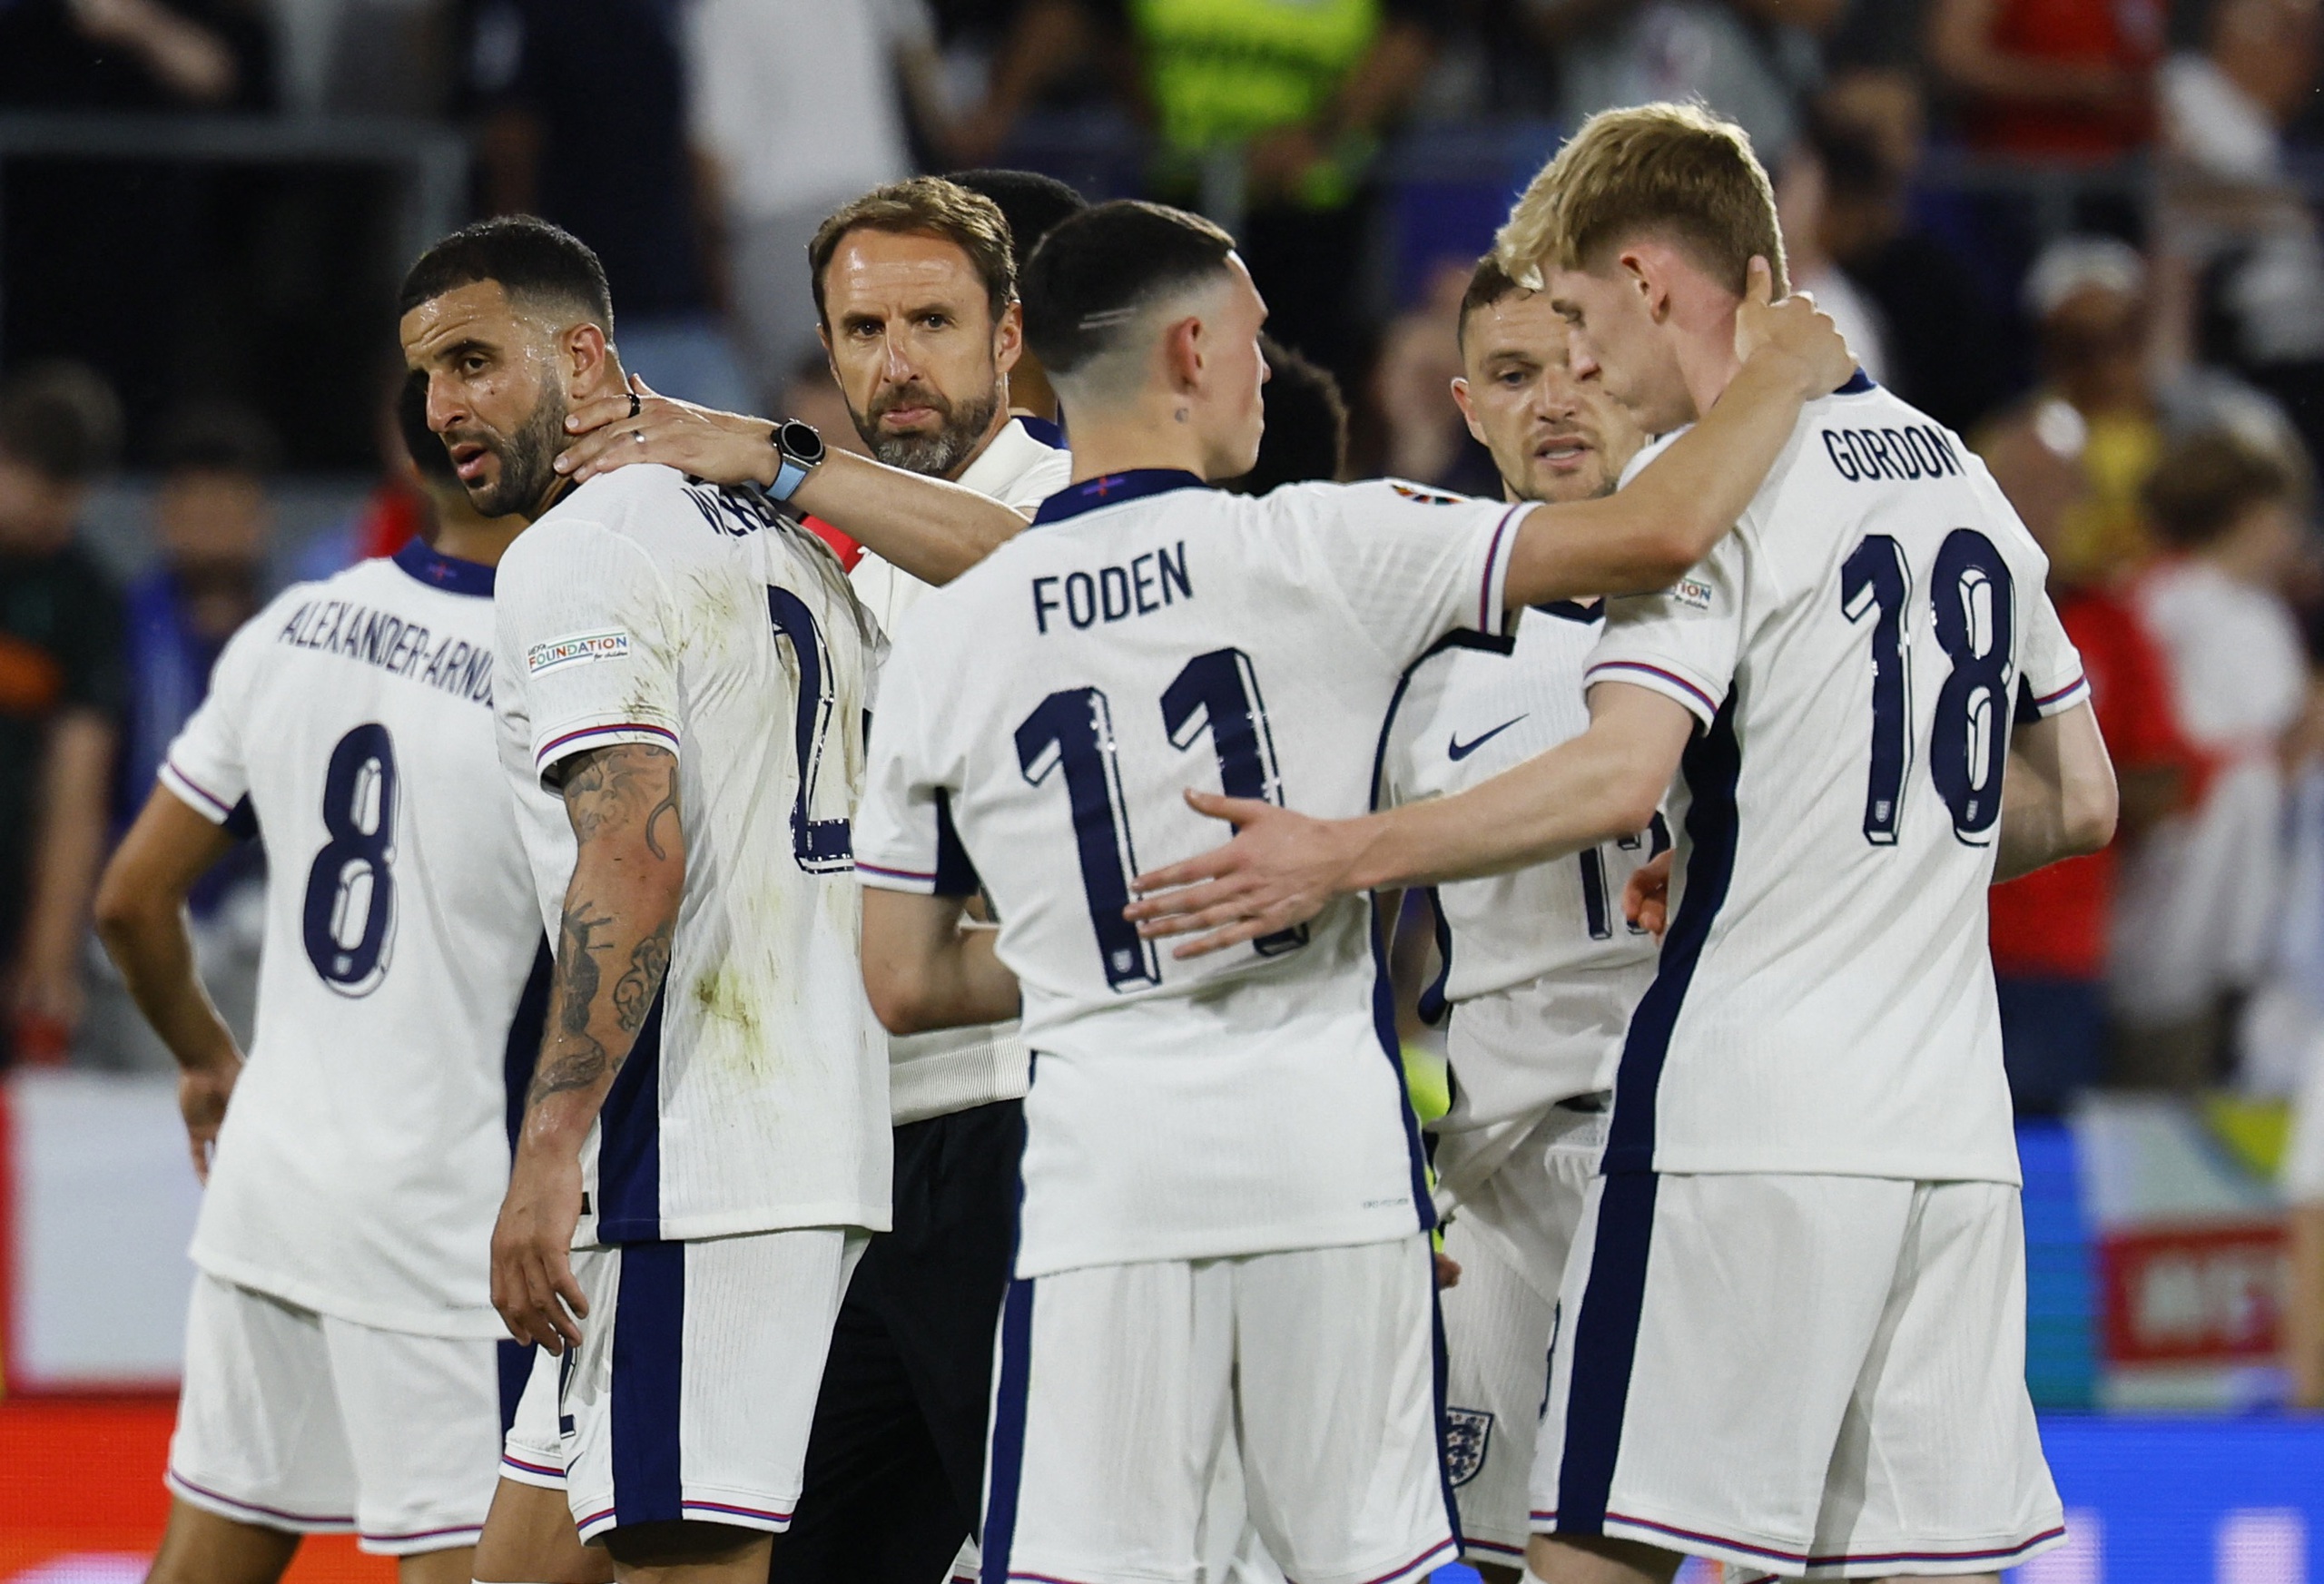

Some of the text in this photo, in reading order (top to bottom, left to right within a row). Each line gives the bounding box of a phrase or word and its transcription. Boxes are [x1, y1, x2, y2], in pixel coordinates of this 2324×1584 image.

[1031, 540, 1195, 635] FODEN
[1821, 424, 1966, 482] GORDON
[277, 600, 494, 710] ALEXANDER-ARNO
[766, 584, 855, 874] 2
[1841, 527, 2016, 847] 18
[302, 723, 402, 999] 8
[1014, 646, 1310, 995] 11
